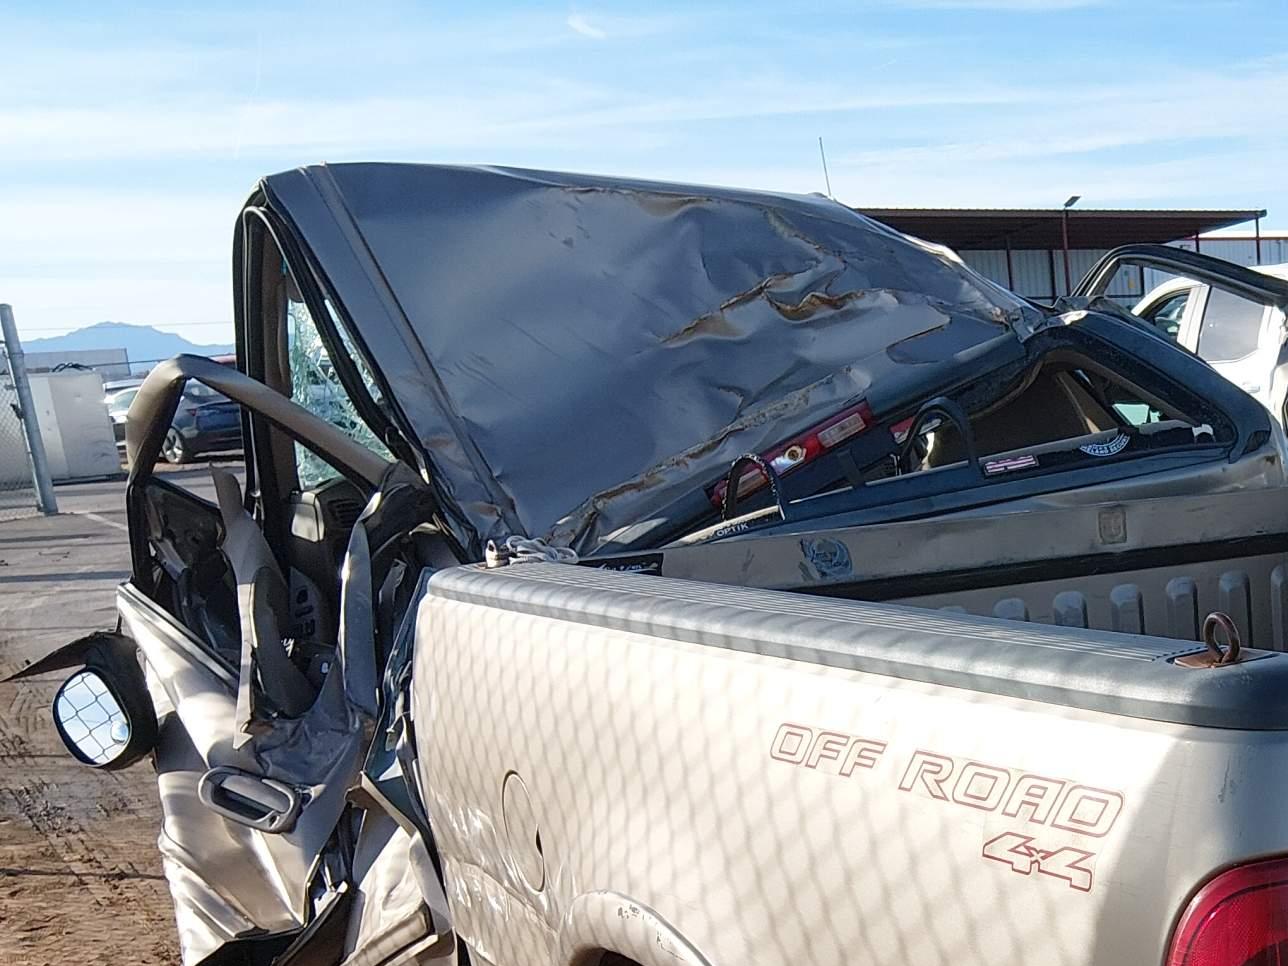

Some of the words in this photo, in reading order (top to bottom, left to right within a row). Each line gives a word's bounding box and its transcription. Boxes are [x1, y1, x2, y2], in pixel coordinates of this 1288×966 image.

[716, 522, 749, 538] OPTIK
[769, 722, 888, 778] OFF
[898, 749, 1126, 838] ROAD
[982, 831, 1097, 893] 4x4
